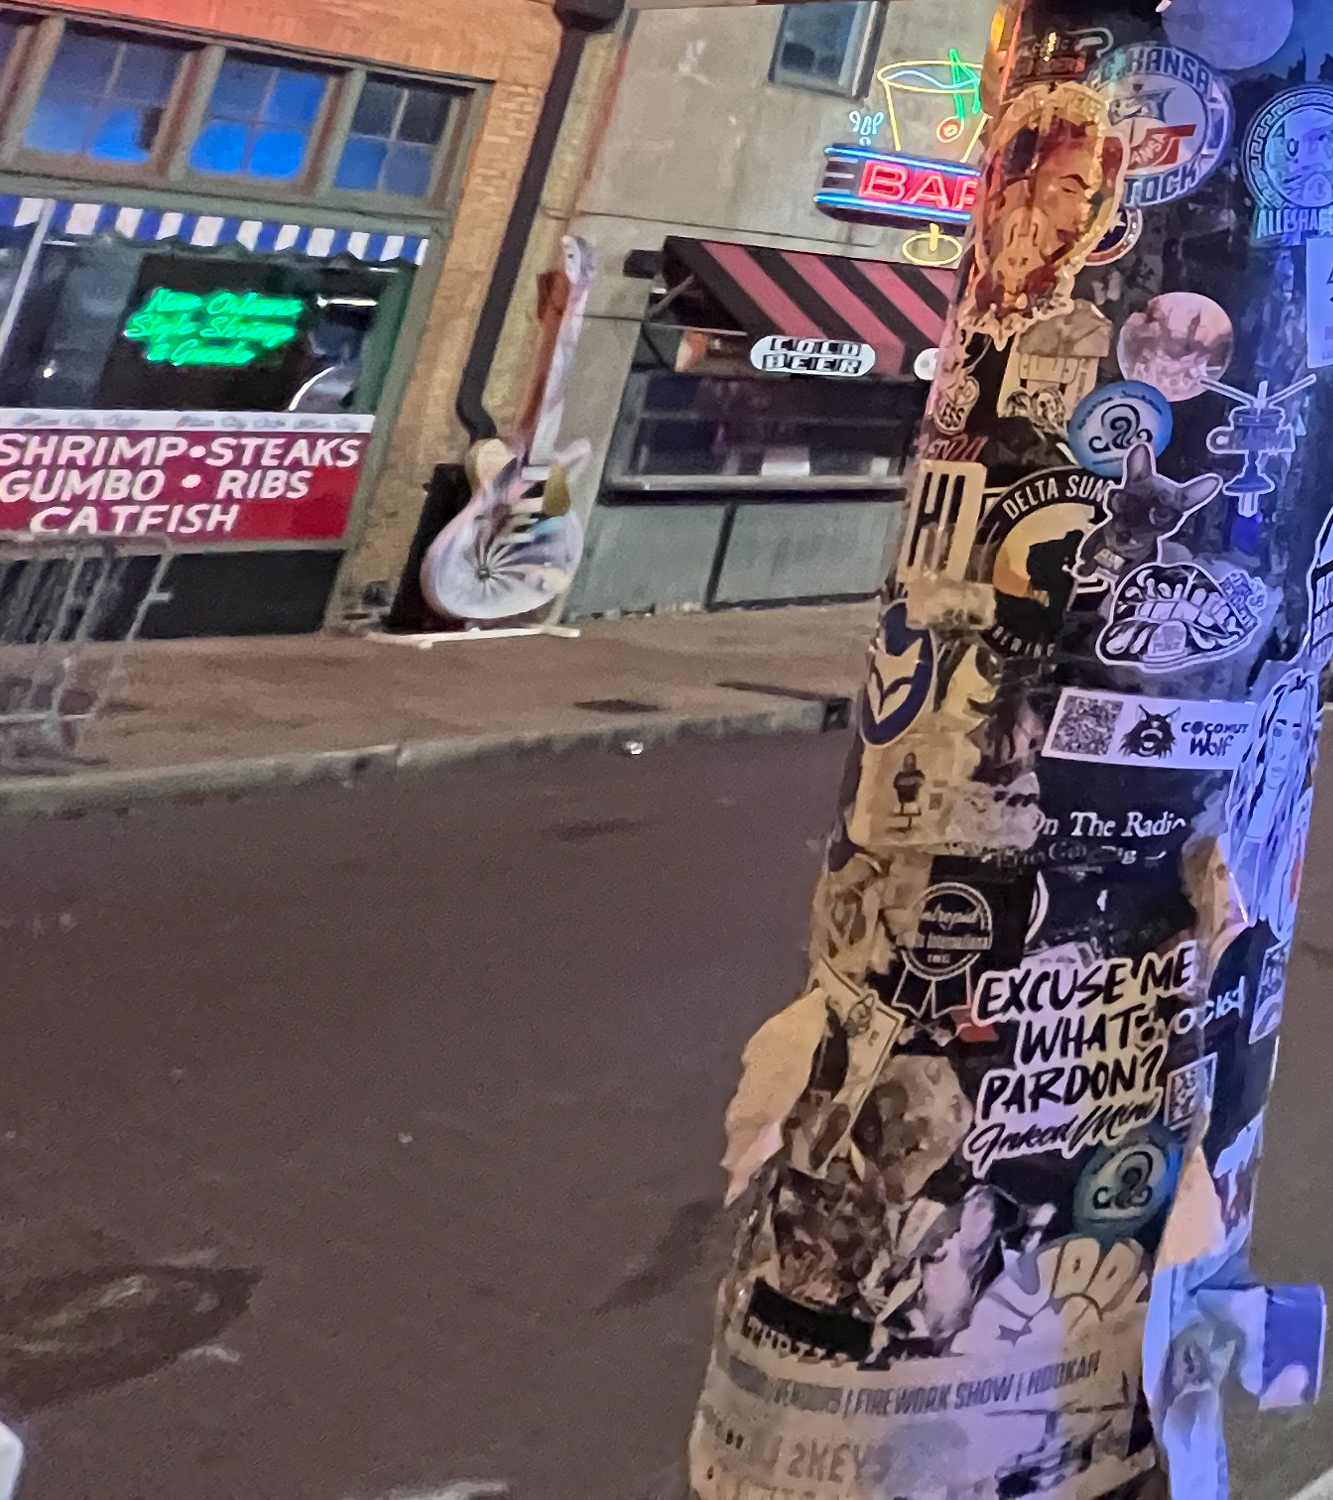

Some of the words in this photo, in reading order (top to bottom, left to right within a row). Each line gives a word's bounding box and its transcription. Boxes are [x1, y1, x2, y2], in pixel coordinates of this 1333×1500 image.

[762, 354, 862, 374] BEER
[0, 432, 190, 467] SHRIMP
[205, 437, 364, 468] STEAKS
[0, 468, 166, 504] GUMBO
[216, 469, 315, 500] RIBS
[1002, 478, 1060, 521] DELTA
[29, 503, 241, 536] CATFISH
[1181, 719, 1249, 734] COCONUT
[1070, 811, 1116, 837] The
[976, 962, 1128, 1019] EXCUSE
[1139, 947, 1194, 996] ME
[1020, 1002, 1147, 1066] WHAT
[981, 1044, 1165, 1121] PARDON?
[954, 1373, 1016, 1410] SHOW
